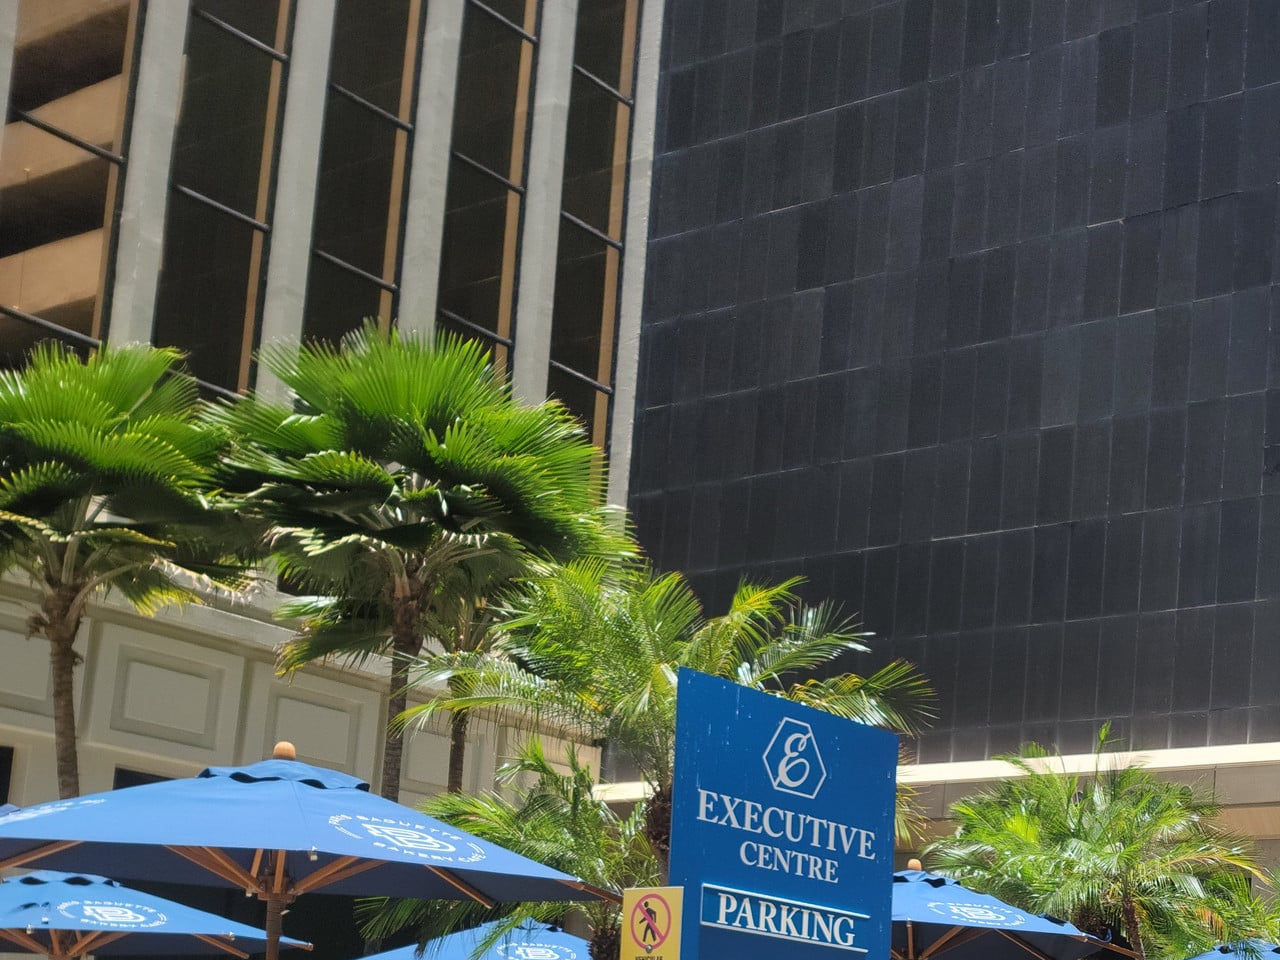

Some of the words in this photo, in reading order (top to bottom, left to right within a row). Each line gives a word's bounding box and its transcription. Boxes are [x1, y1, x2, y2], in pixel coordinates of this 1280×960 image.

[697, 788, 876, 861] EXECUTIVE
[739, 841, 839, 884] CENTRE
[716, 892, 857, 947] PARKING
